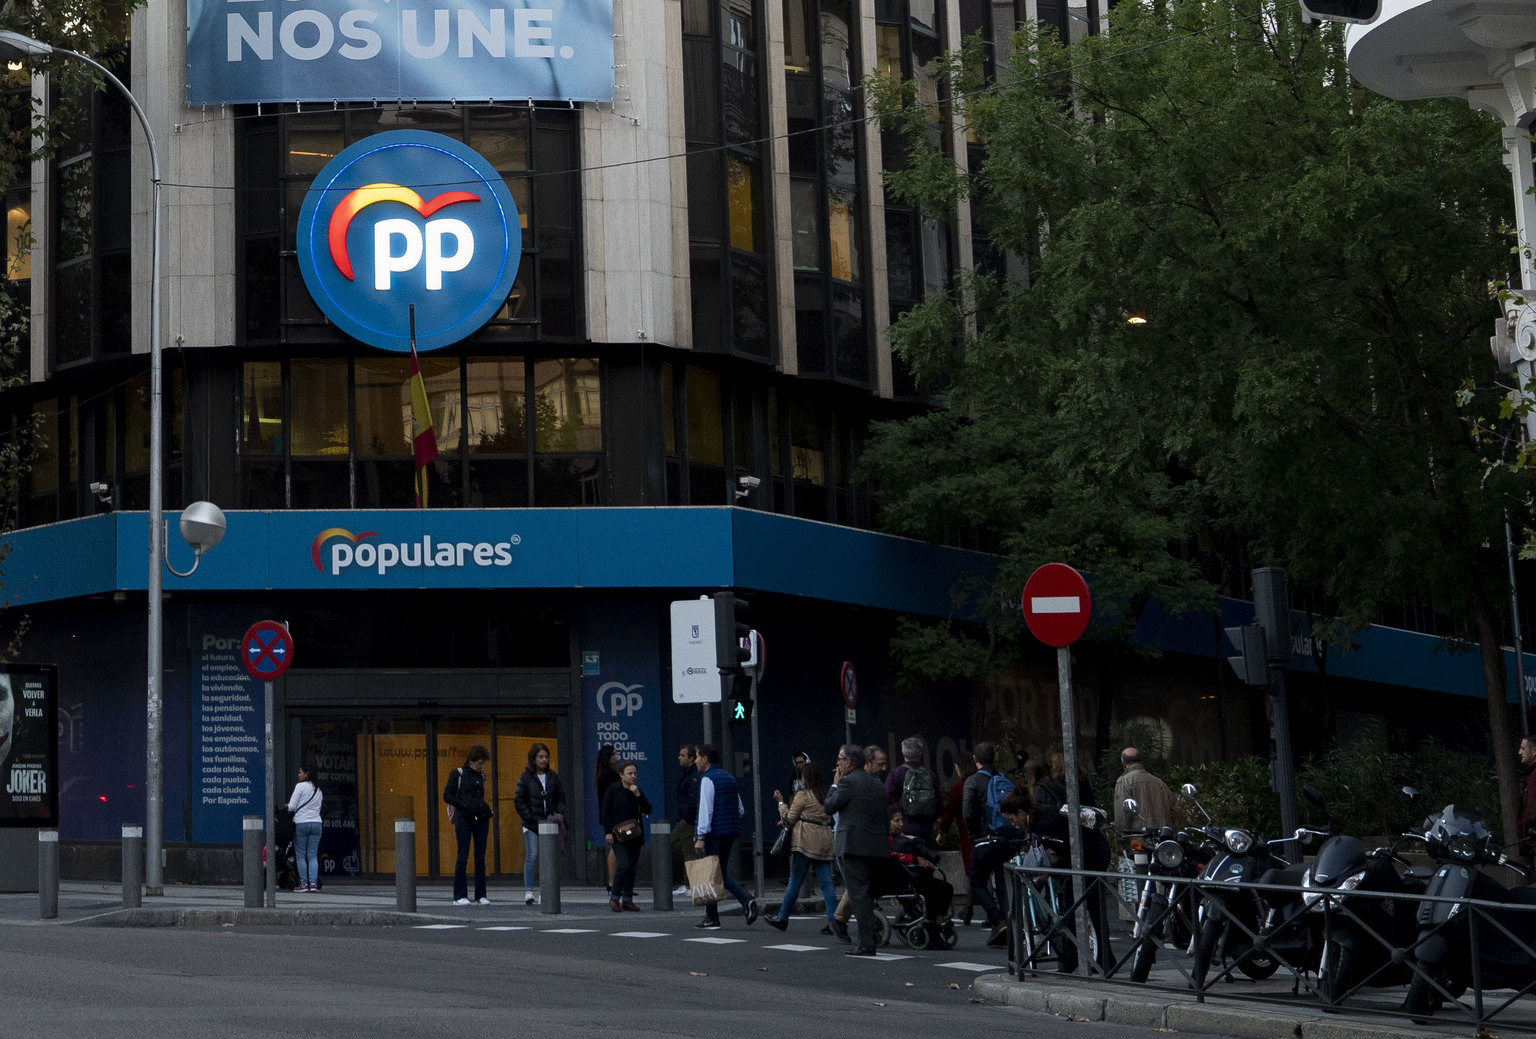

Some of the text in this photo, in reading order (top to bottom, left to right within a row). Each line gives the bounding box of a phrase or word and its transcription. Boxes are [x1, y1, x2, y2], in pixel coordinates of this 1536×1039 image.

[226, 8, 574, 61] NOS UNE.
[374, 218, 475, 291] pp
[202, 634, 241, 650] Por:
[209, 654, 236, 662] futuro,
[210, 664, 239, 673] empleo,
[210, 684, 245, 692] vivienda,
[23, 690, 44, 699] VOLVER
[25, 708, 43, 717] VERLA
[209, 715, 243, 723] sanidad,
[597, 722, 620, 731] POR
[214, 735, 258, 744] empleados,
[597, 732, 628, 740] TODO
[614, 742, 636, 750] QUE
[214, 755, 247, 763] familias,
[622, 752, 647, 760] UNE.
[316, 755, 355, 770] VOTAR
[6, 769, 46, 794] JOKER
[223, 776, 251, 785] pueblo,
[202, 796, 249, 805] Por España.
